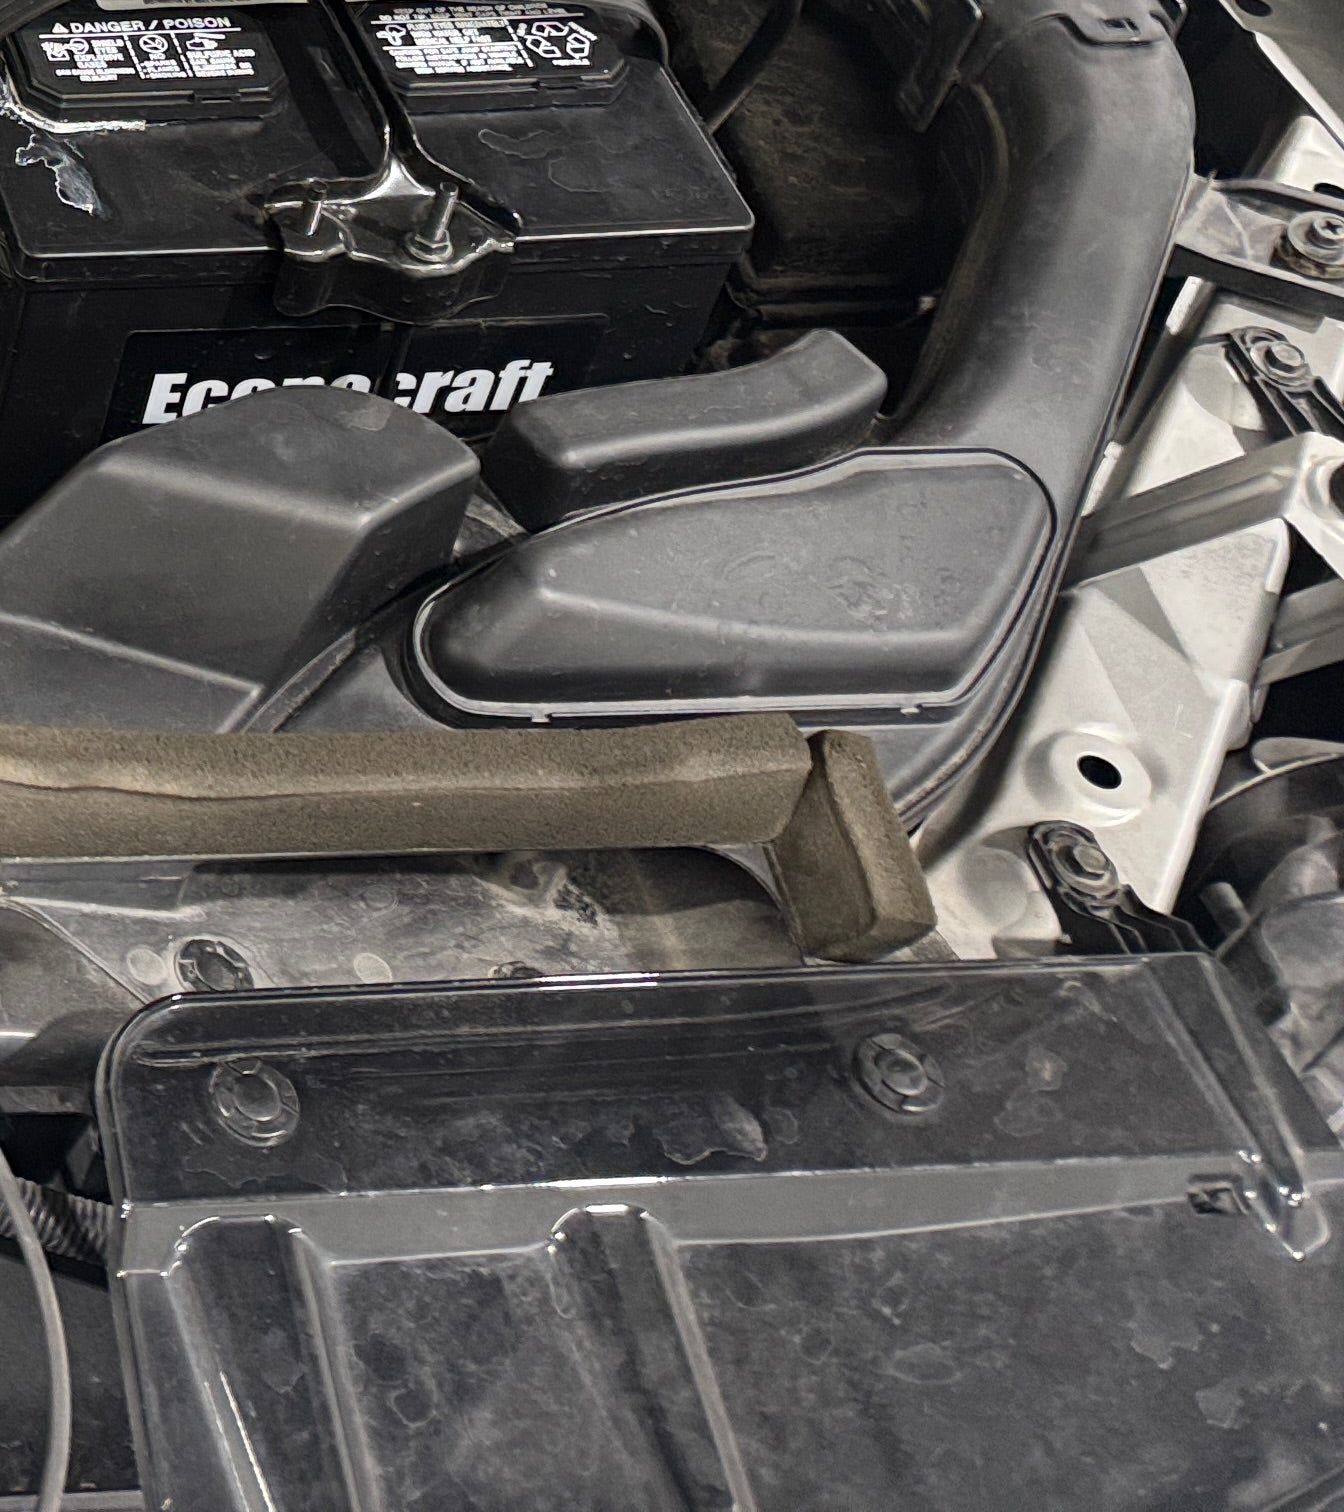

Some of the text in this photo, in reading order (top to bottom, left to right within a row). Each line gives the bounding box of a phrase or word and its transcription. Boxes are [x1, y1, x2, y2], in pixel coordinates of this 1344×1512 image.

[70, 17, 231, 33] DANGER / POISON
